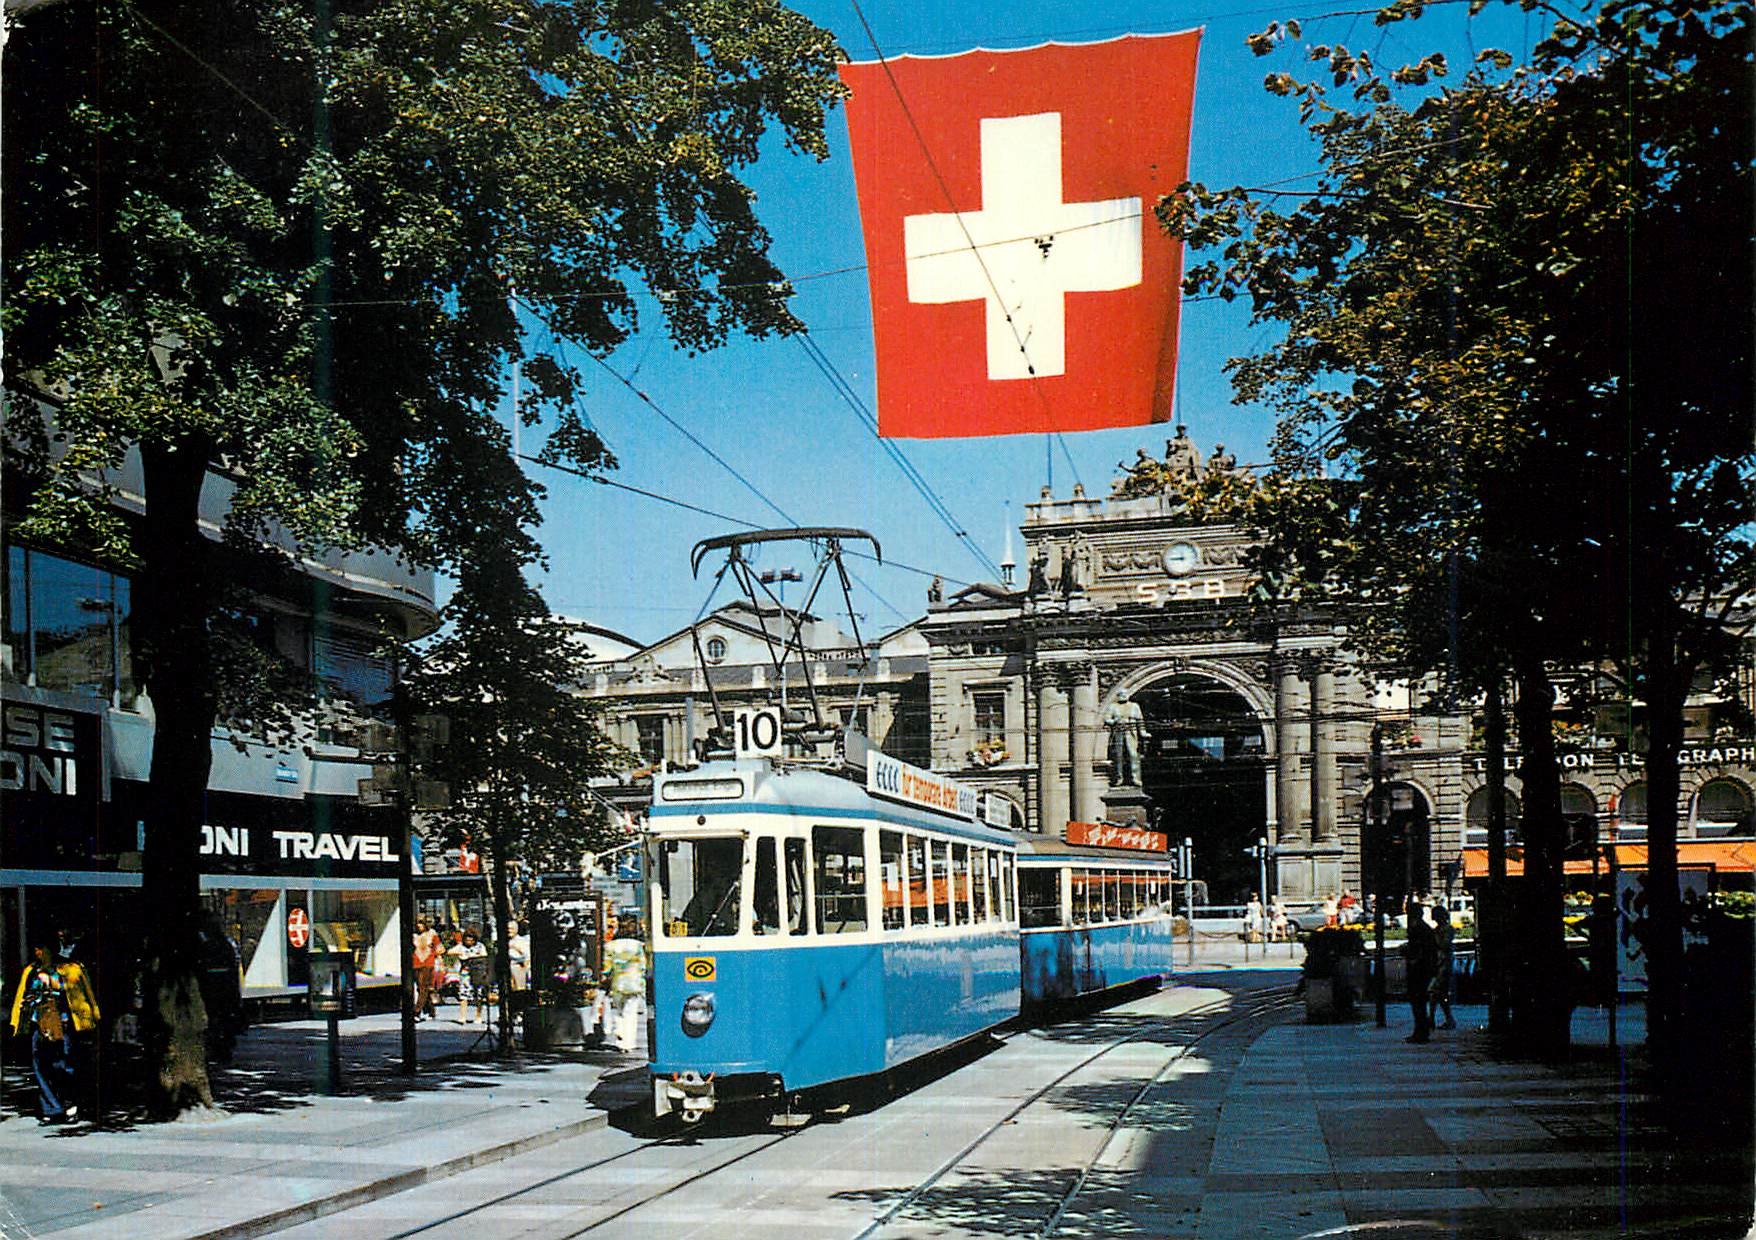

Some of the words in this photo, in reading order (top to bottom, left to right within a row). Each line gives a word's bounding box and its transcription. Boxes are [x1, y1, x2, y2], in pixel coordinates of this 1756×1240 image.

[6, 706, 75, 752] SE
[736, 712, 777, 751] 10
[272, 830, 400, 862] TRAVEL
